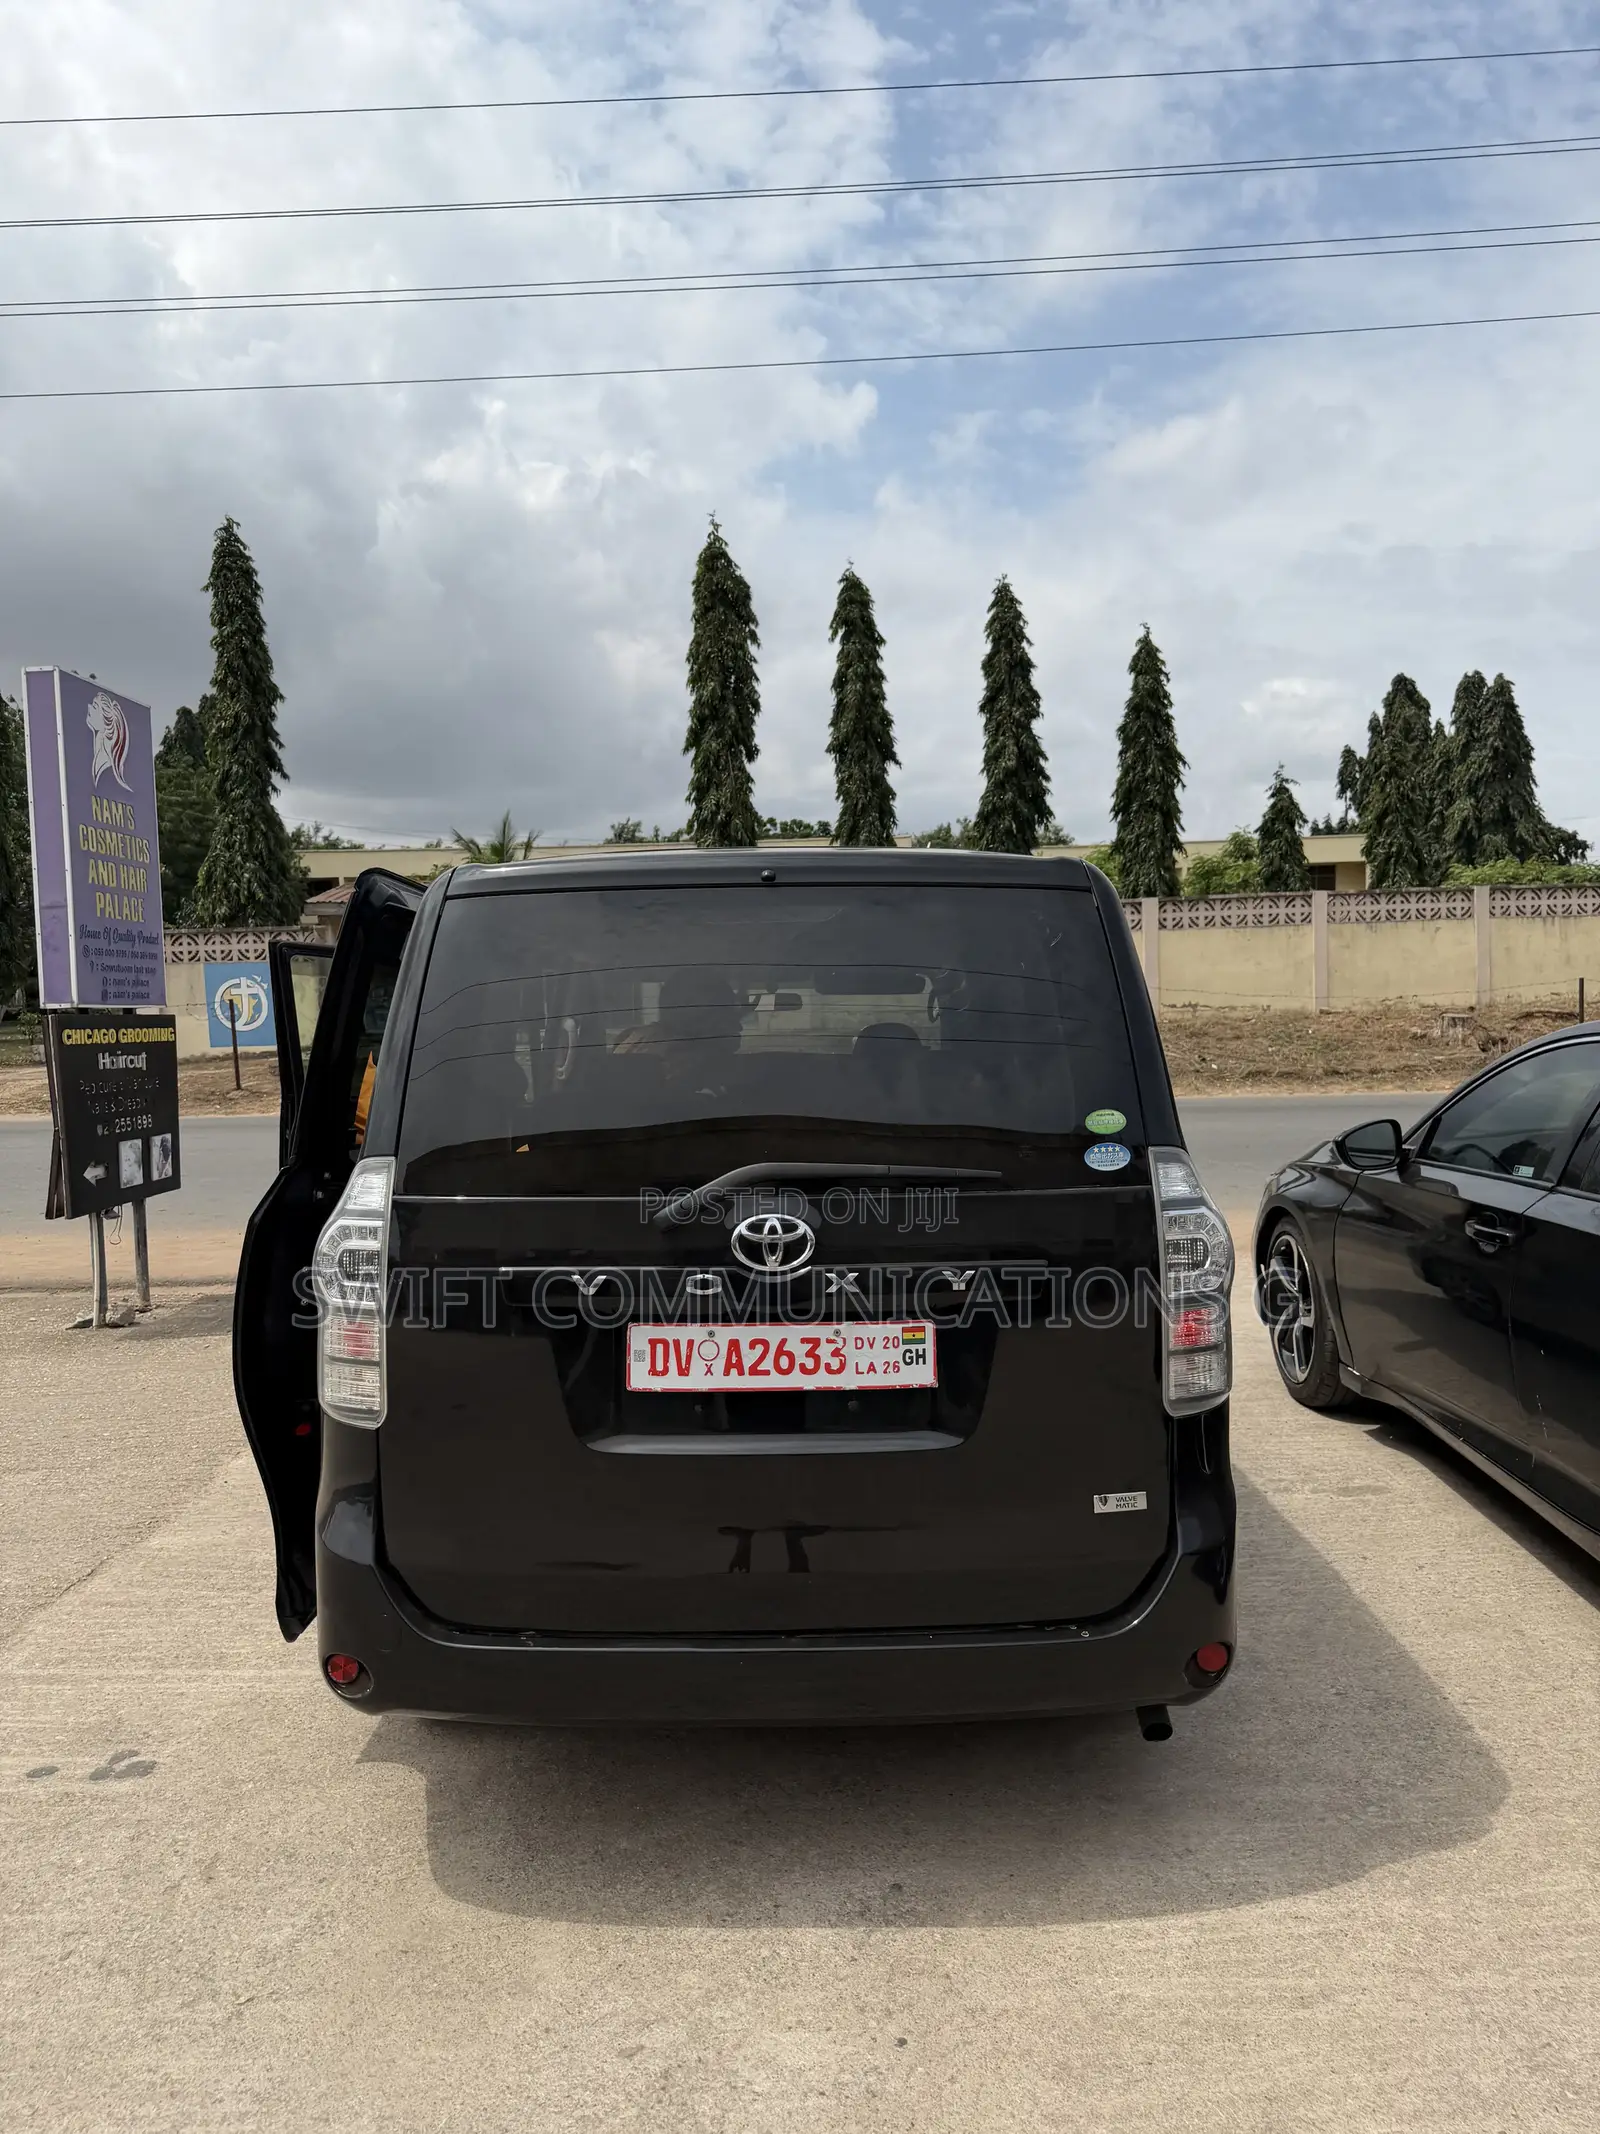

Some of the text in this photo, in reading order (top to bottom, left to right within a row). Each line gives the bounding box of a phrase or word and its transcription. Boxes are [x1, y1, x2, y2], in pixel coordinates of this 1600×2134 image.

[91, 794, 135, 830] NAM'S
[79, 823, 150, 864] COSMETICS
[88, 858, 148, 893] AND HAIR
[95, 891, 145, 923] PALACE
[80, 924, 101, 940] Home
[62, 1027, 175, 1046] CHICAGO GROOMING
[97, 1050, 148, 1071] Haircut
[854, 1335, 900, 1350] DV 20
[647, 1336, 847, 1377] DV A2633
[901, 1347, 927, 1366] GH
[854, 1359, 900, 1375] LA 26
[1115, 1495, 1138, 1503] VALVE
